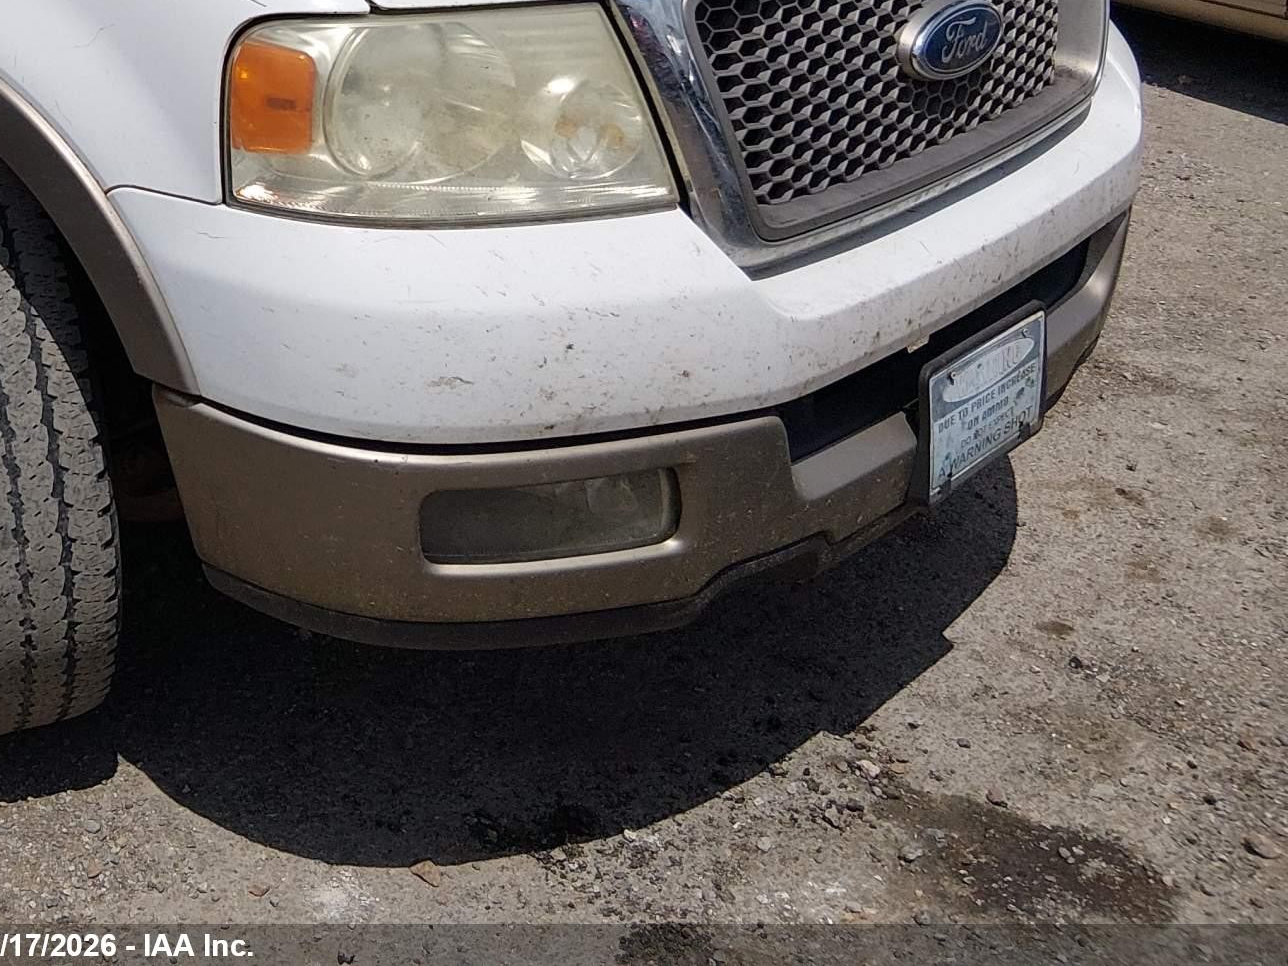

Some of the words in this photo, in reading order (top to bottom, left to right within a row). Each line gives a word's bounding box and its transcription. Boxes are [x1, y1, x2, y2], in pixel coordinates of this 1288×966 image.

[941, 17, 988, 64] Ford
[939, 415, 957, 434] DUE
[958, 407, 969, 420] TO
[971, 389, 996, 412] PRICE
[997, 362, 1036, 395] INCREASE
[967, 416, 979, 430] ON
[939, 466, 946, 478] A
[950, 428, 1002, 470] WARNING
[1004, 405, 1033, 435] SHOT
